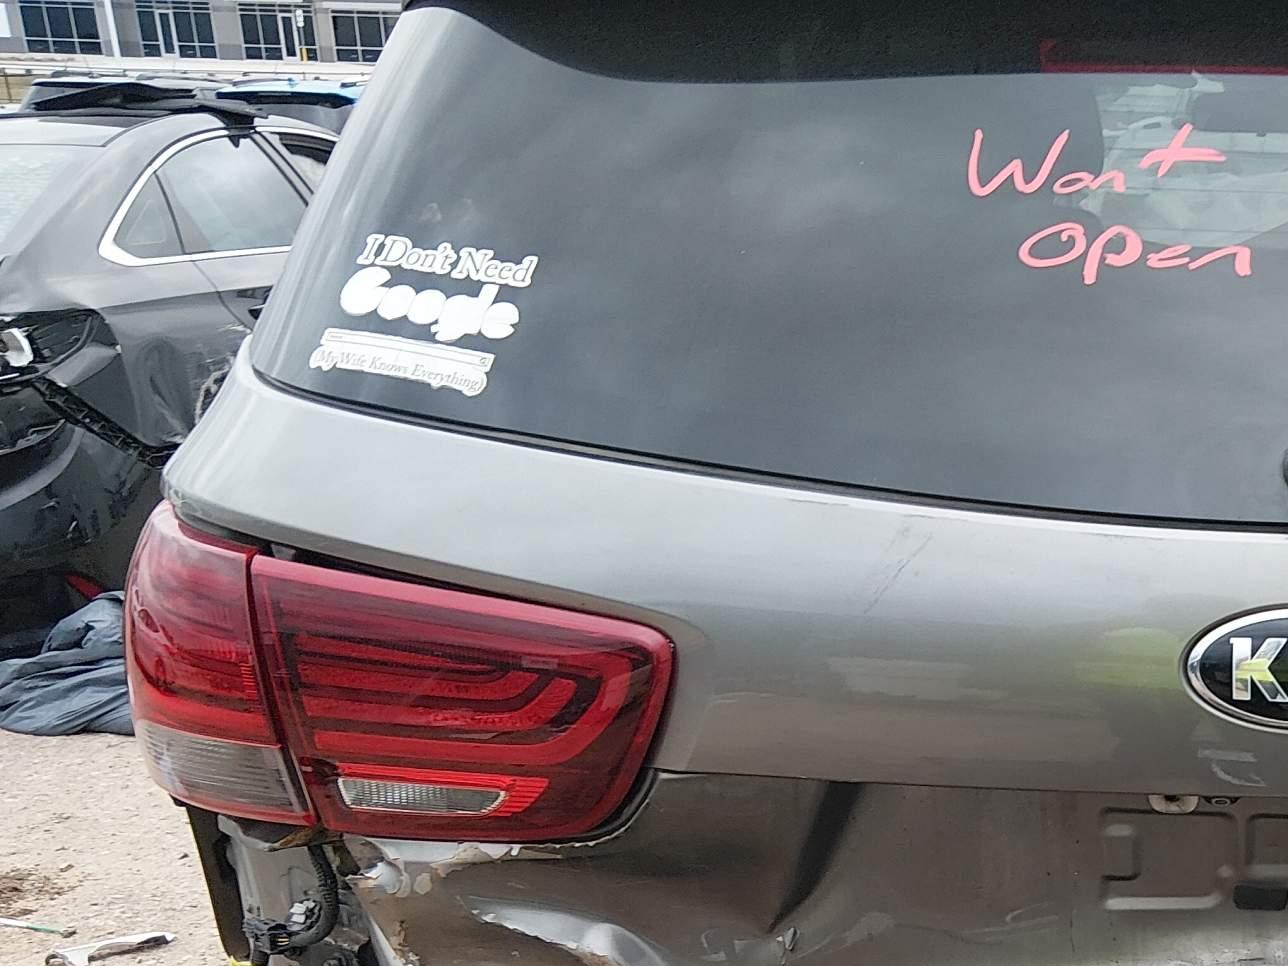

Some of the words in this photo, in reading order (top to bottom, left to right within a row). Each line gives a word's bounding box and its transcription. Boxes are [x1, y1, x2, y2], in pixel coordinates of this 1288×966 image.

[359, 235, 384, 264] I
[378, 236, 456, 274] Don't
[453, 248, 538, 287] Need
[340, 266, 520, 342] Google
[368, 354, 408, 374] Knows
